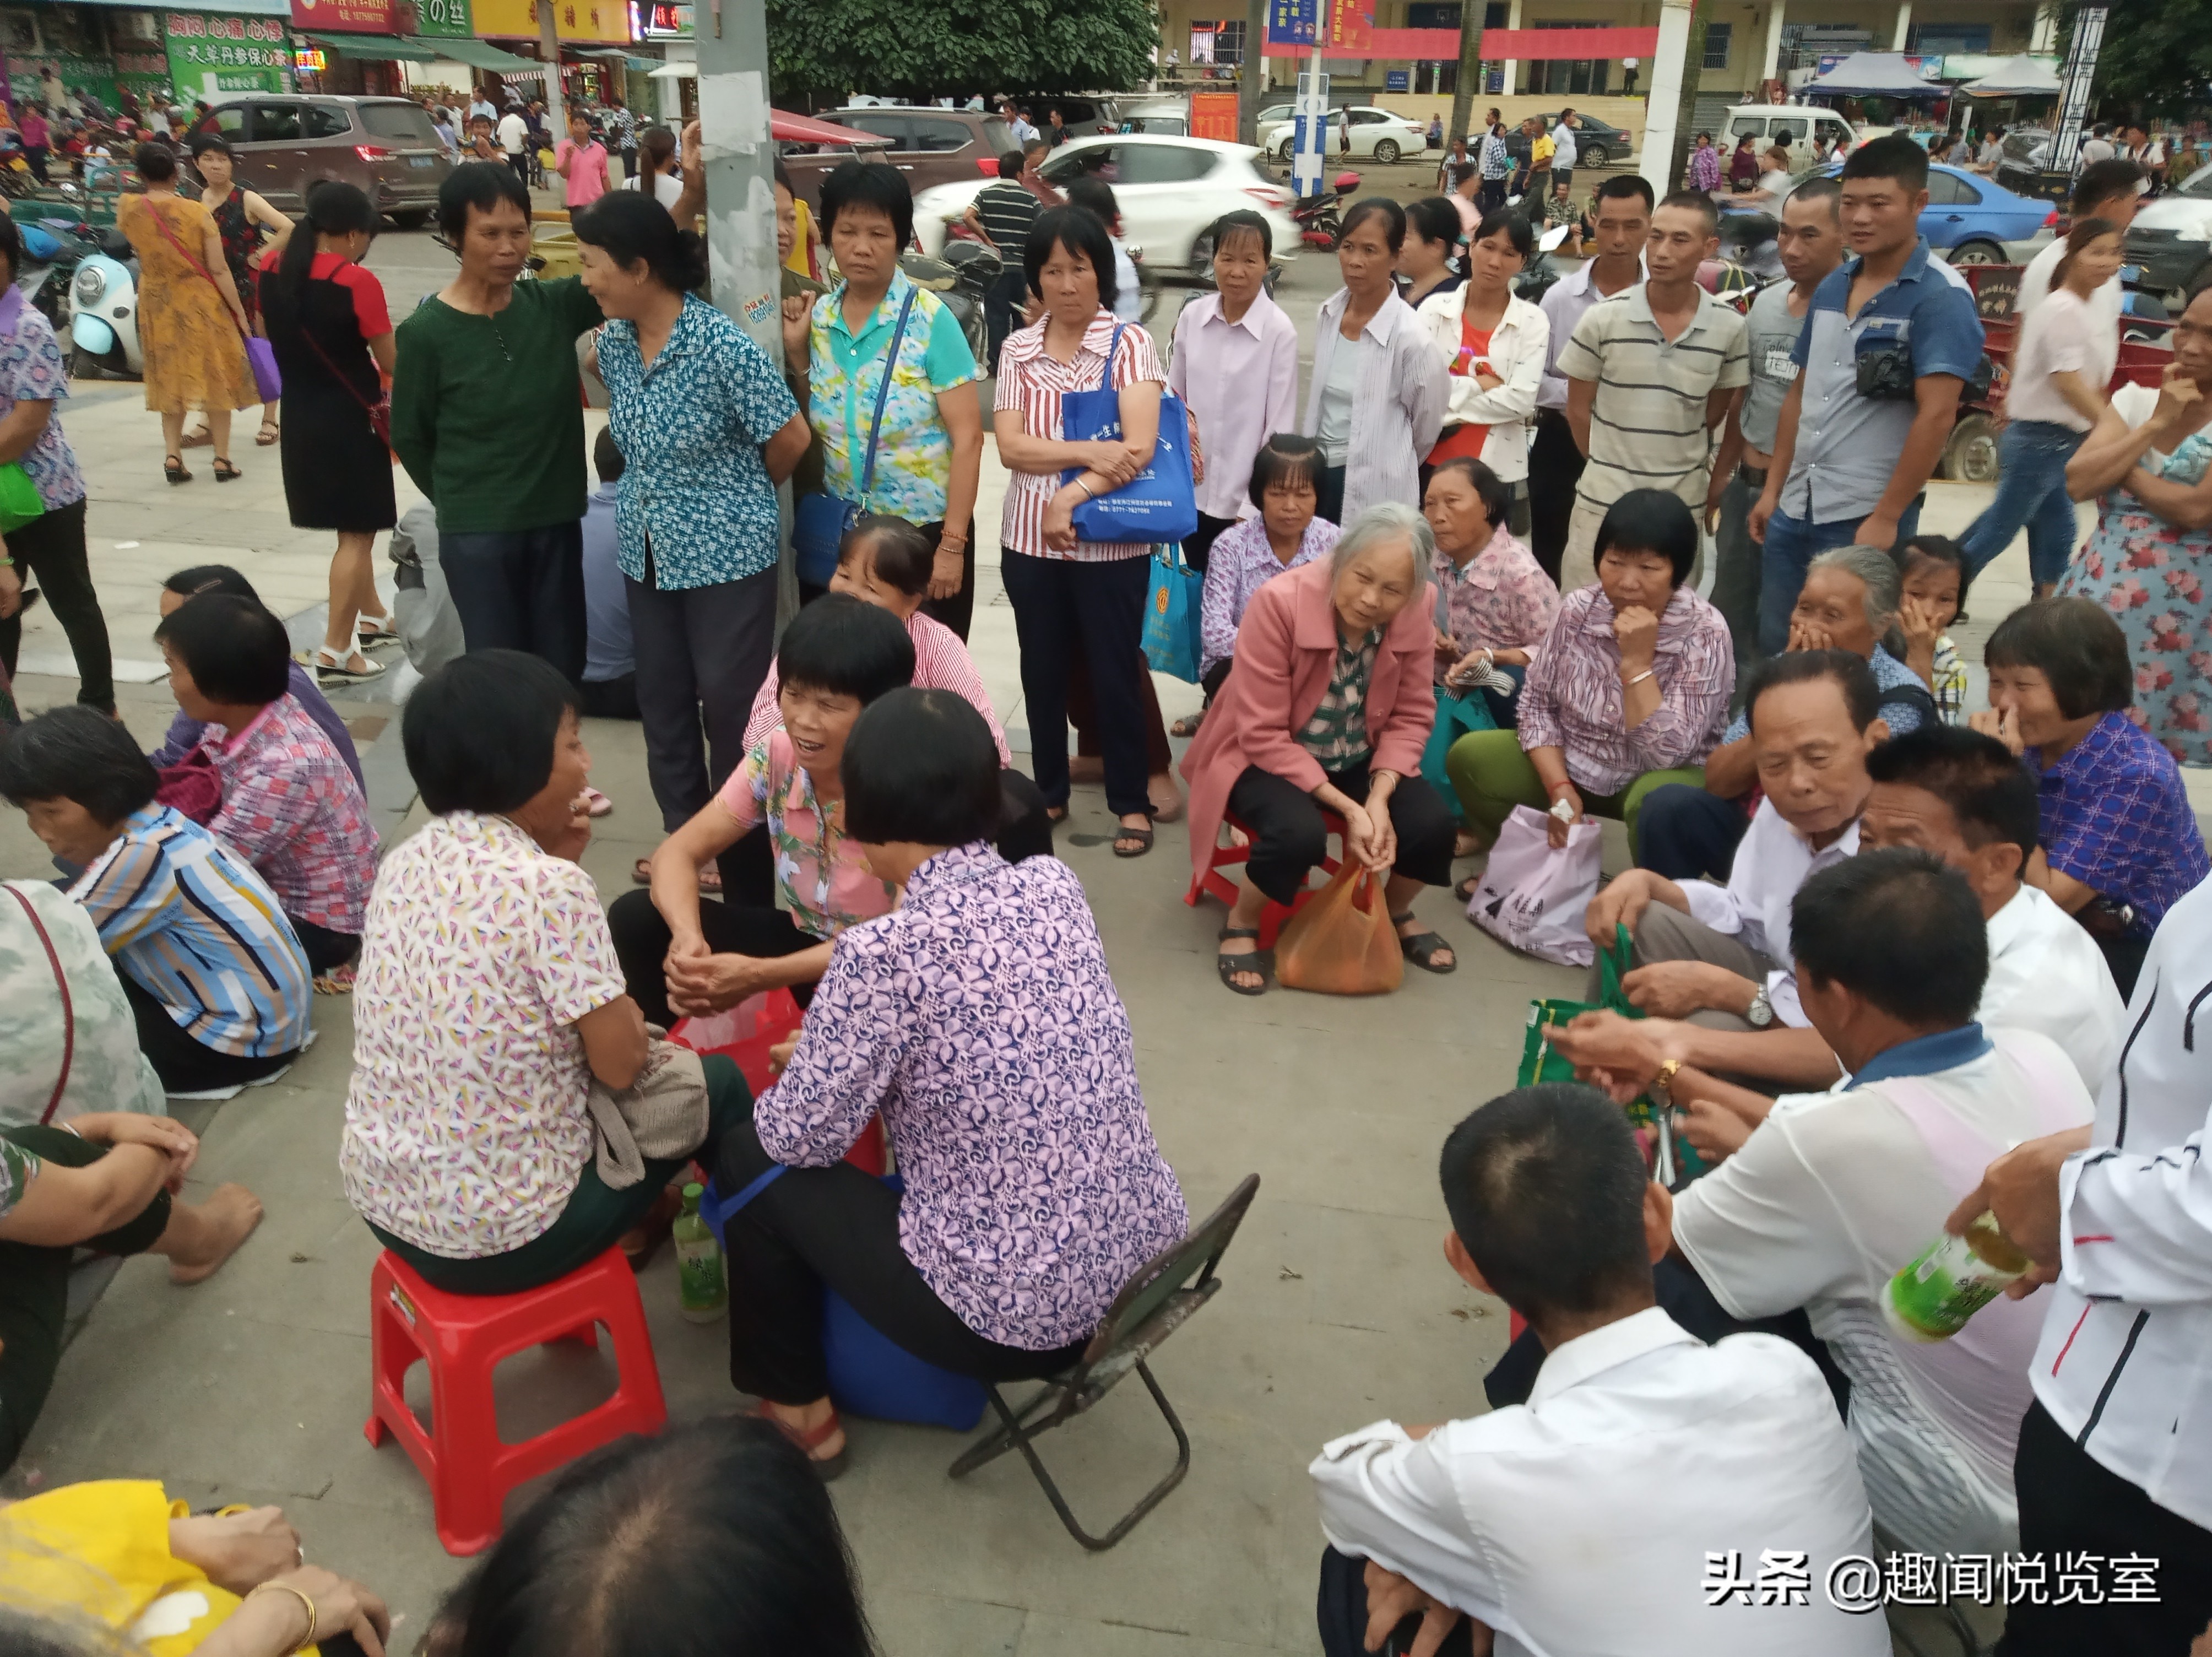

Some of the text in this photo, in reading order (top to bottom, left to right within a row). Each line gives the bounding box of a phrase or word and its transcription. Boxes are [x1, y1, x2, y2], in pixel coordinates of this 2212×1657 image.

[167, 14, 284, 42] 胸闷 心痛 心悸
